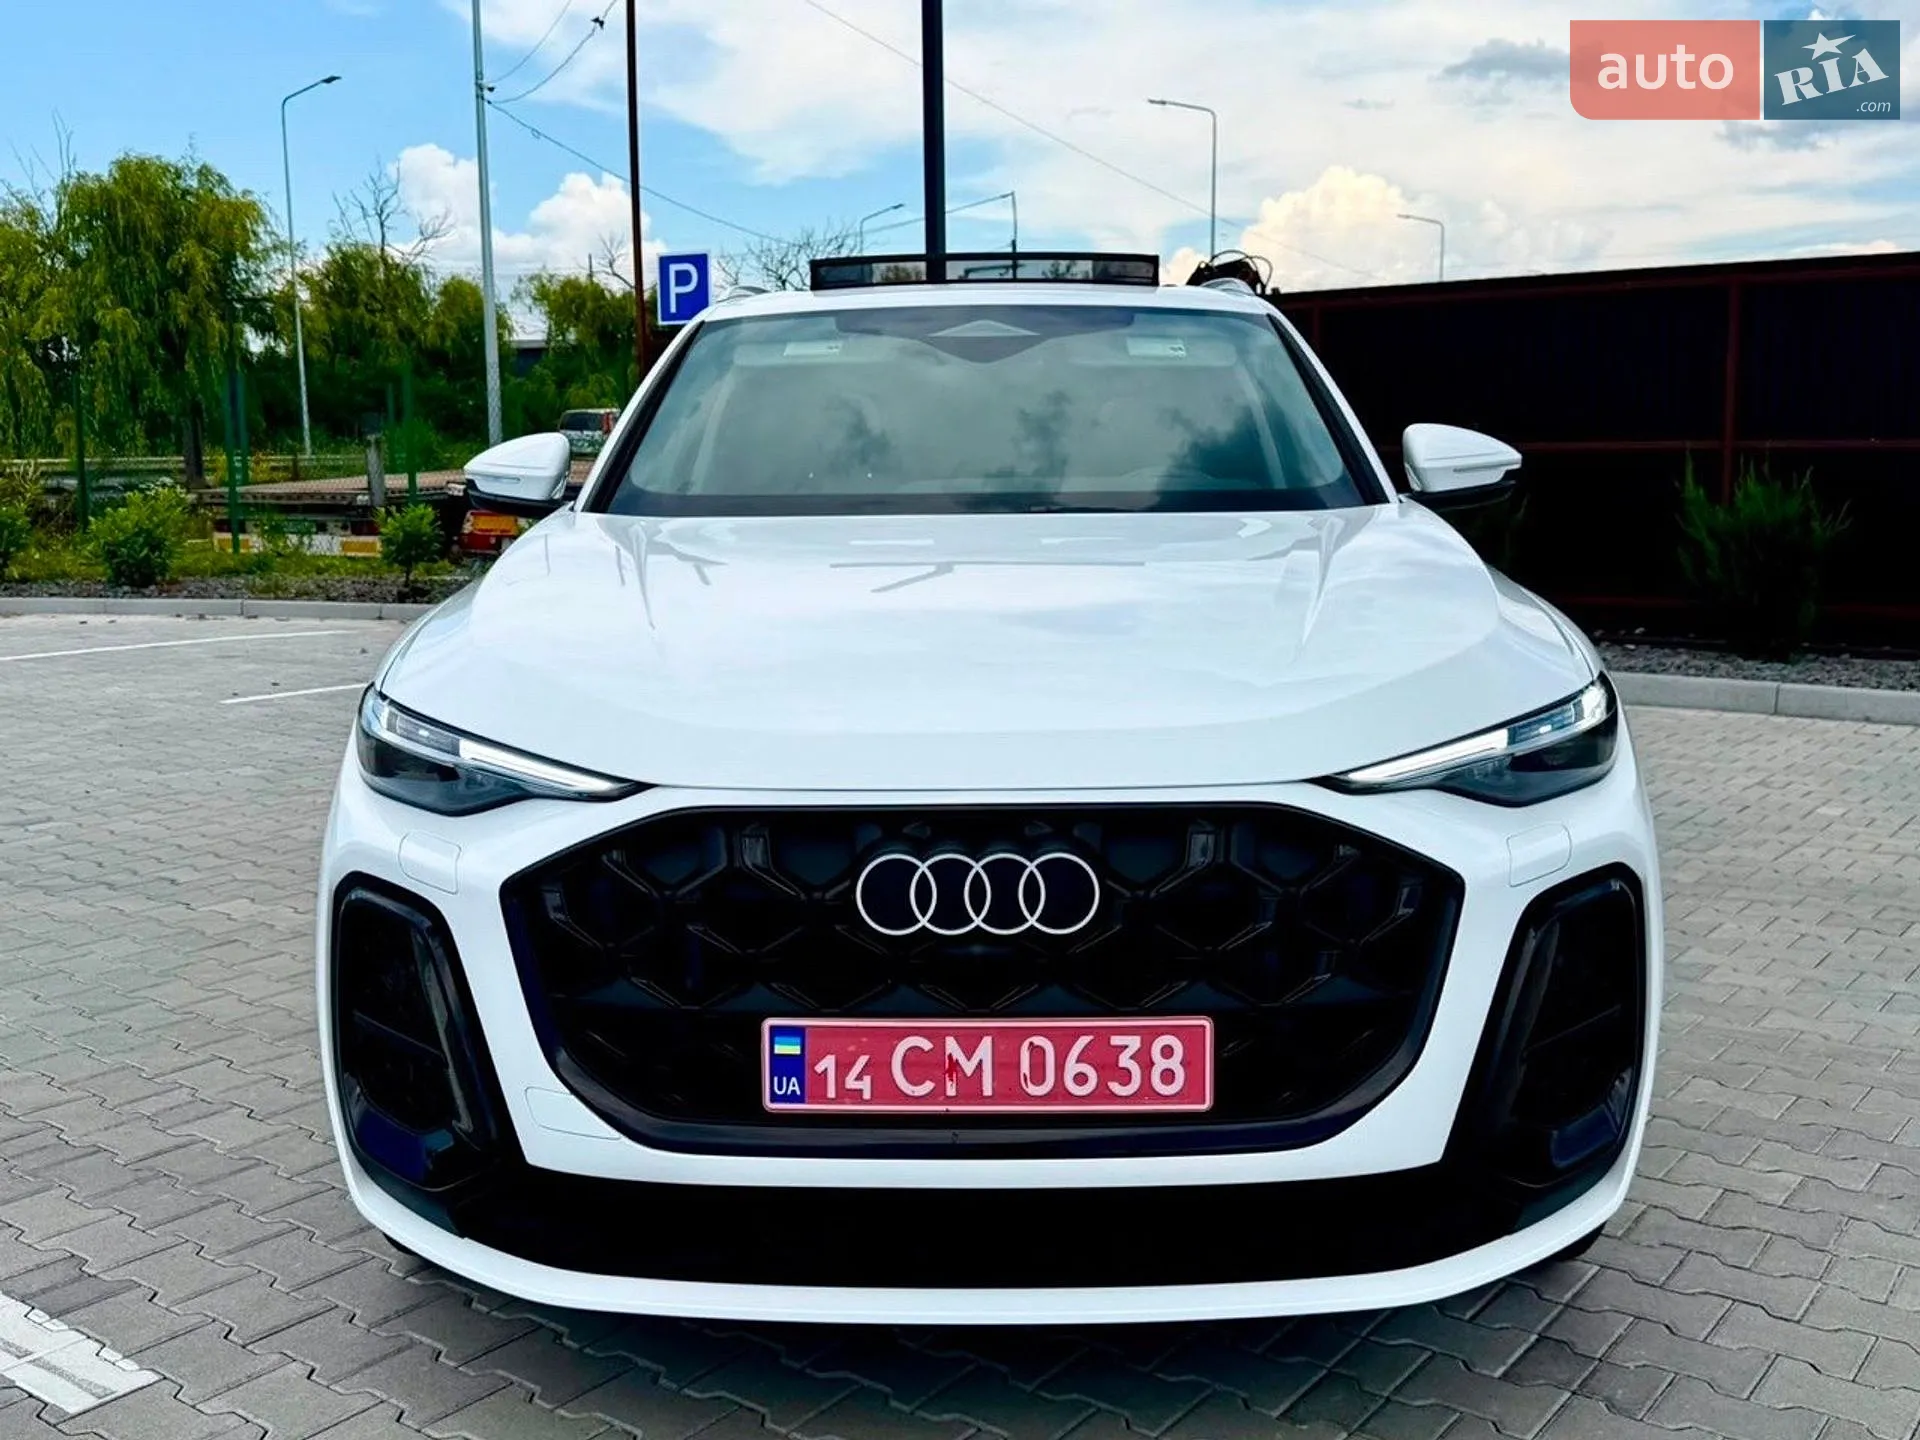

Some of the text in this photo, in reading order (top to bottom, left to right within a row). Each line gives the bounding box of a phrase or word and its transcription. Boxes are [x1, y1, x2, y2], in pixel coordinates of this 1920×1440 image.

[669, 262, 698, 314] P
[773, 1076, 801, 1096] UA
[814, 1035, 1186, 1100] 14 CM 0638
